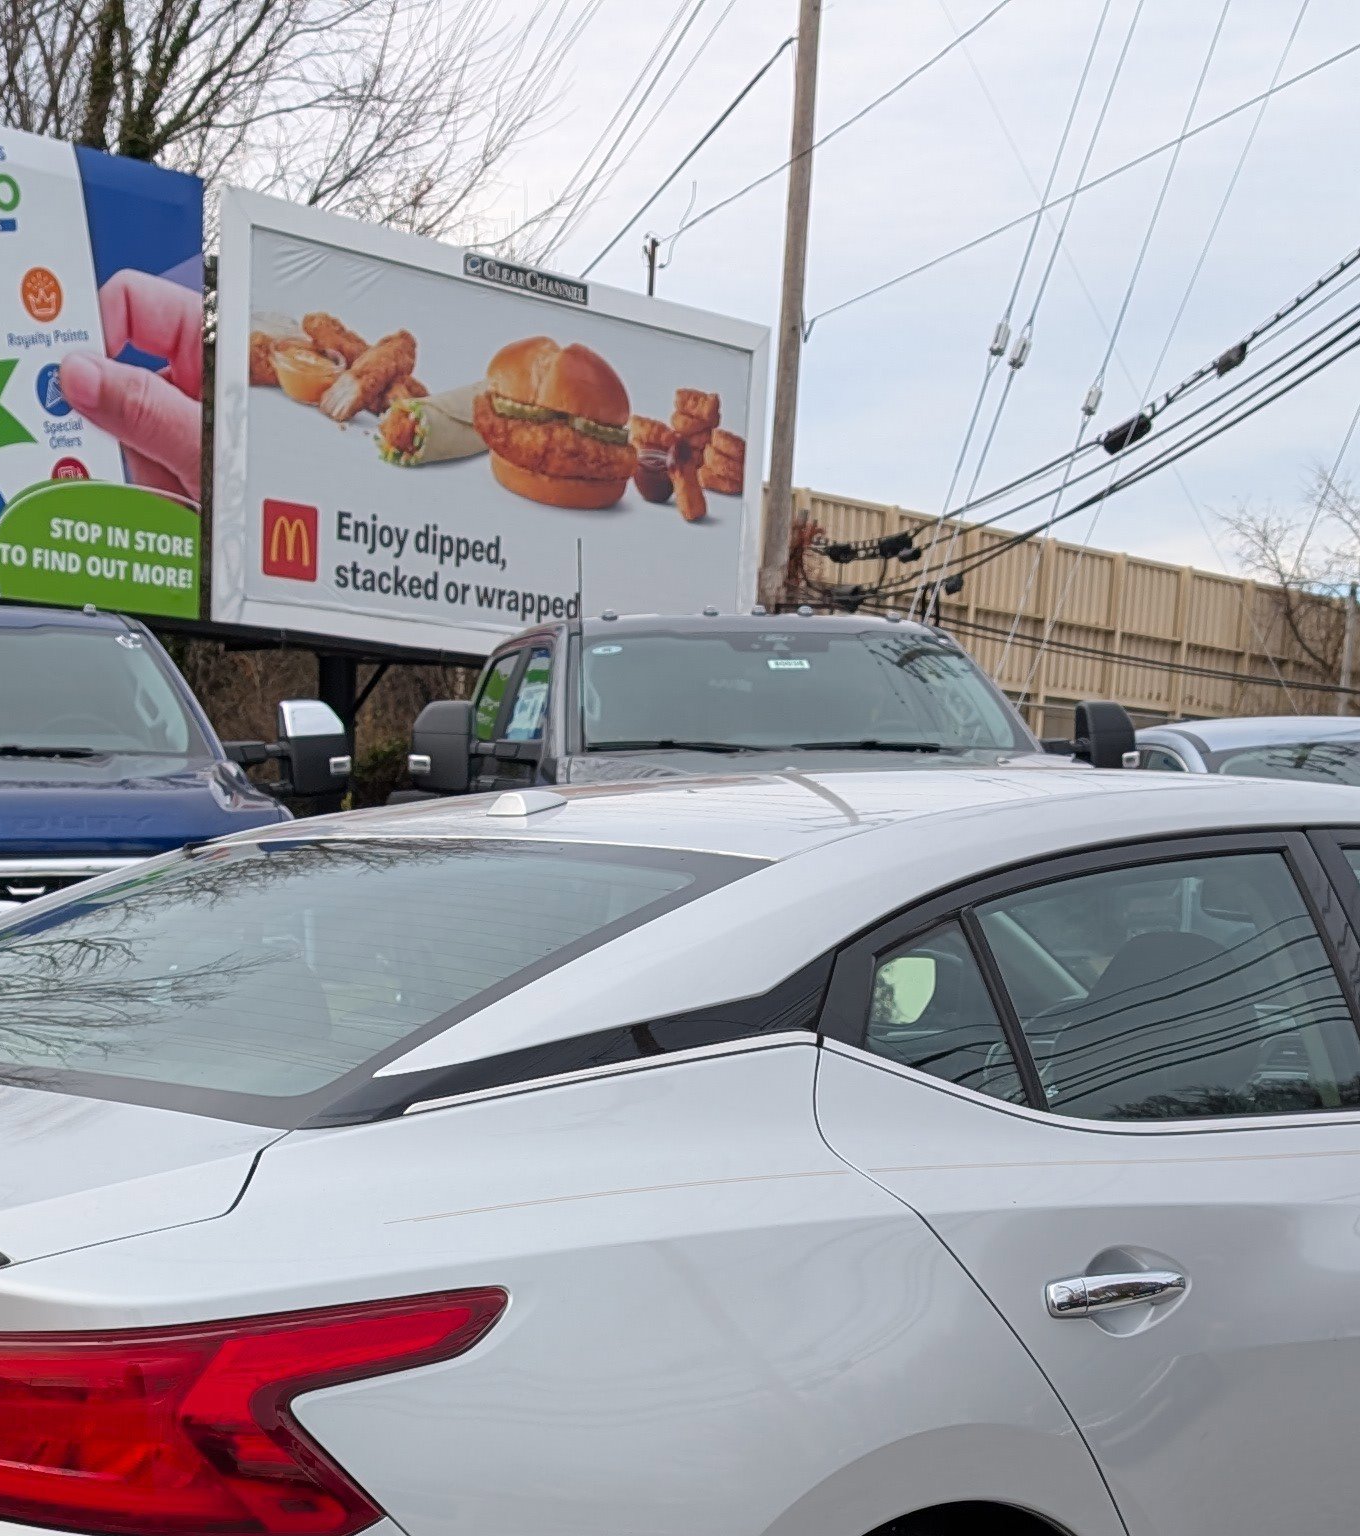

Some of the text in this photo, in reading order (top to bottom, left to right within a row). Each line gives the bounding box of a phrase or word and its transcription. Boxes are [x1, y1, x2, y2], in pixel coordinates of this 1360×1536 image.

[7, 329, 90, 348] Royalty Points
[43, 418, 83, 433] Special
[49, 436, 83, 449] Offers
[50, 517, 194, 558] STOP IN STORE
[336, 510, 508, 571] Enjoy dipped,
[31, 548, 81, 574] FIND
[86, 556, 128, 581] OUT
[132, 563, 193, 589] MORE!
[334, 561, 438, 602] stacked
[445, 580, 470, 604] or
